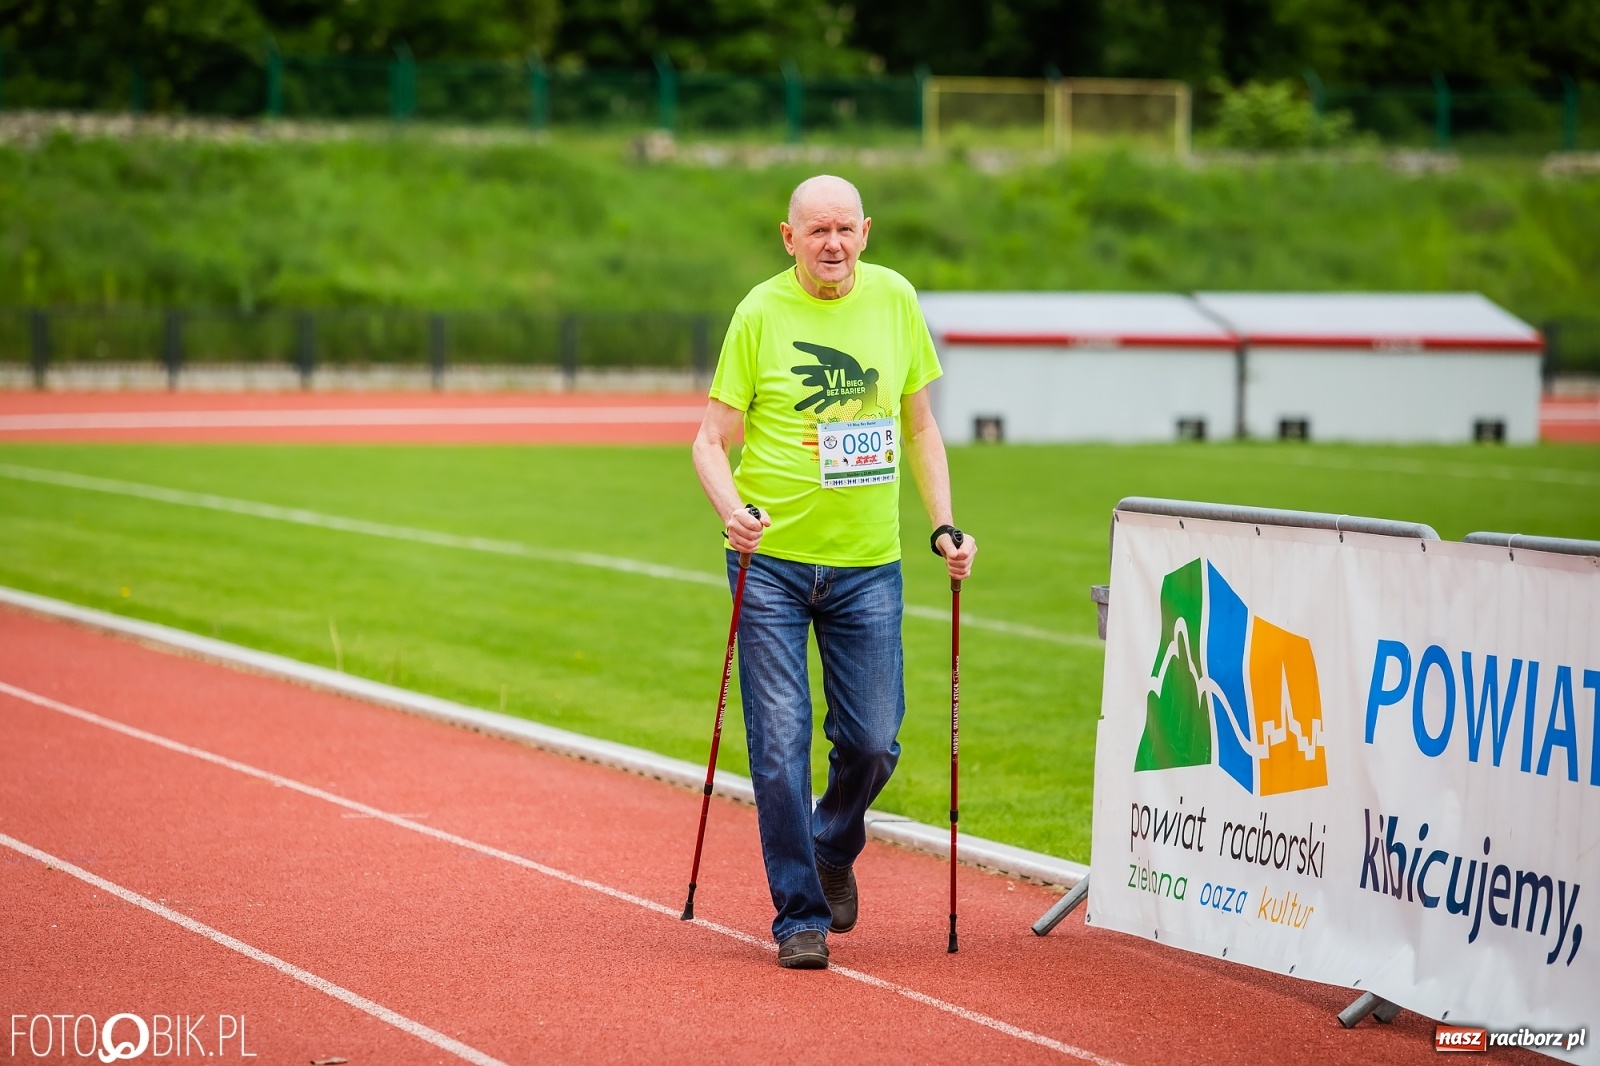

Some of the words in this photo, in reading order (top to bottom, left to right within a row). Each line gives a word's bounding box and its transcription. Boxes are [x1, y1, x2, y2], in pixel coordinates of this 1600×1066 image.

[824, 368, 846, 388] VI
[846, 379, 864, 387] BIEG
[826, 388, 840, 396] BEZ
[840, 387, 866, 395] BARIER
[842, 431, 882, 455] 080
[1365, 638, 1600, 787] POWIAT
[1130, 796, 1207, 855] powiat
[1221, 813, 1326, 878] raciborski
[1127, 857, 1188, 901] zielona
[1257, 886, 1315, 928] kultur
[1359, 808, 1583, 967] kibicujemy,
